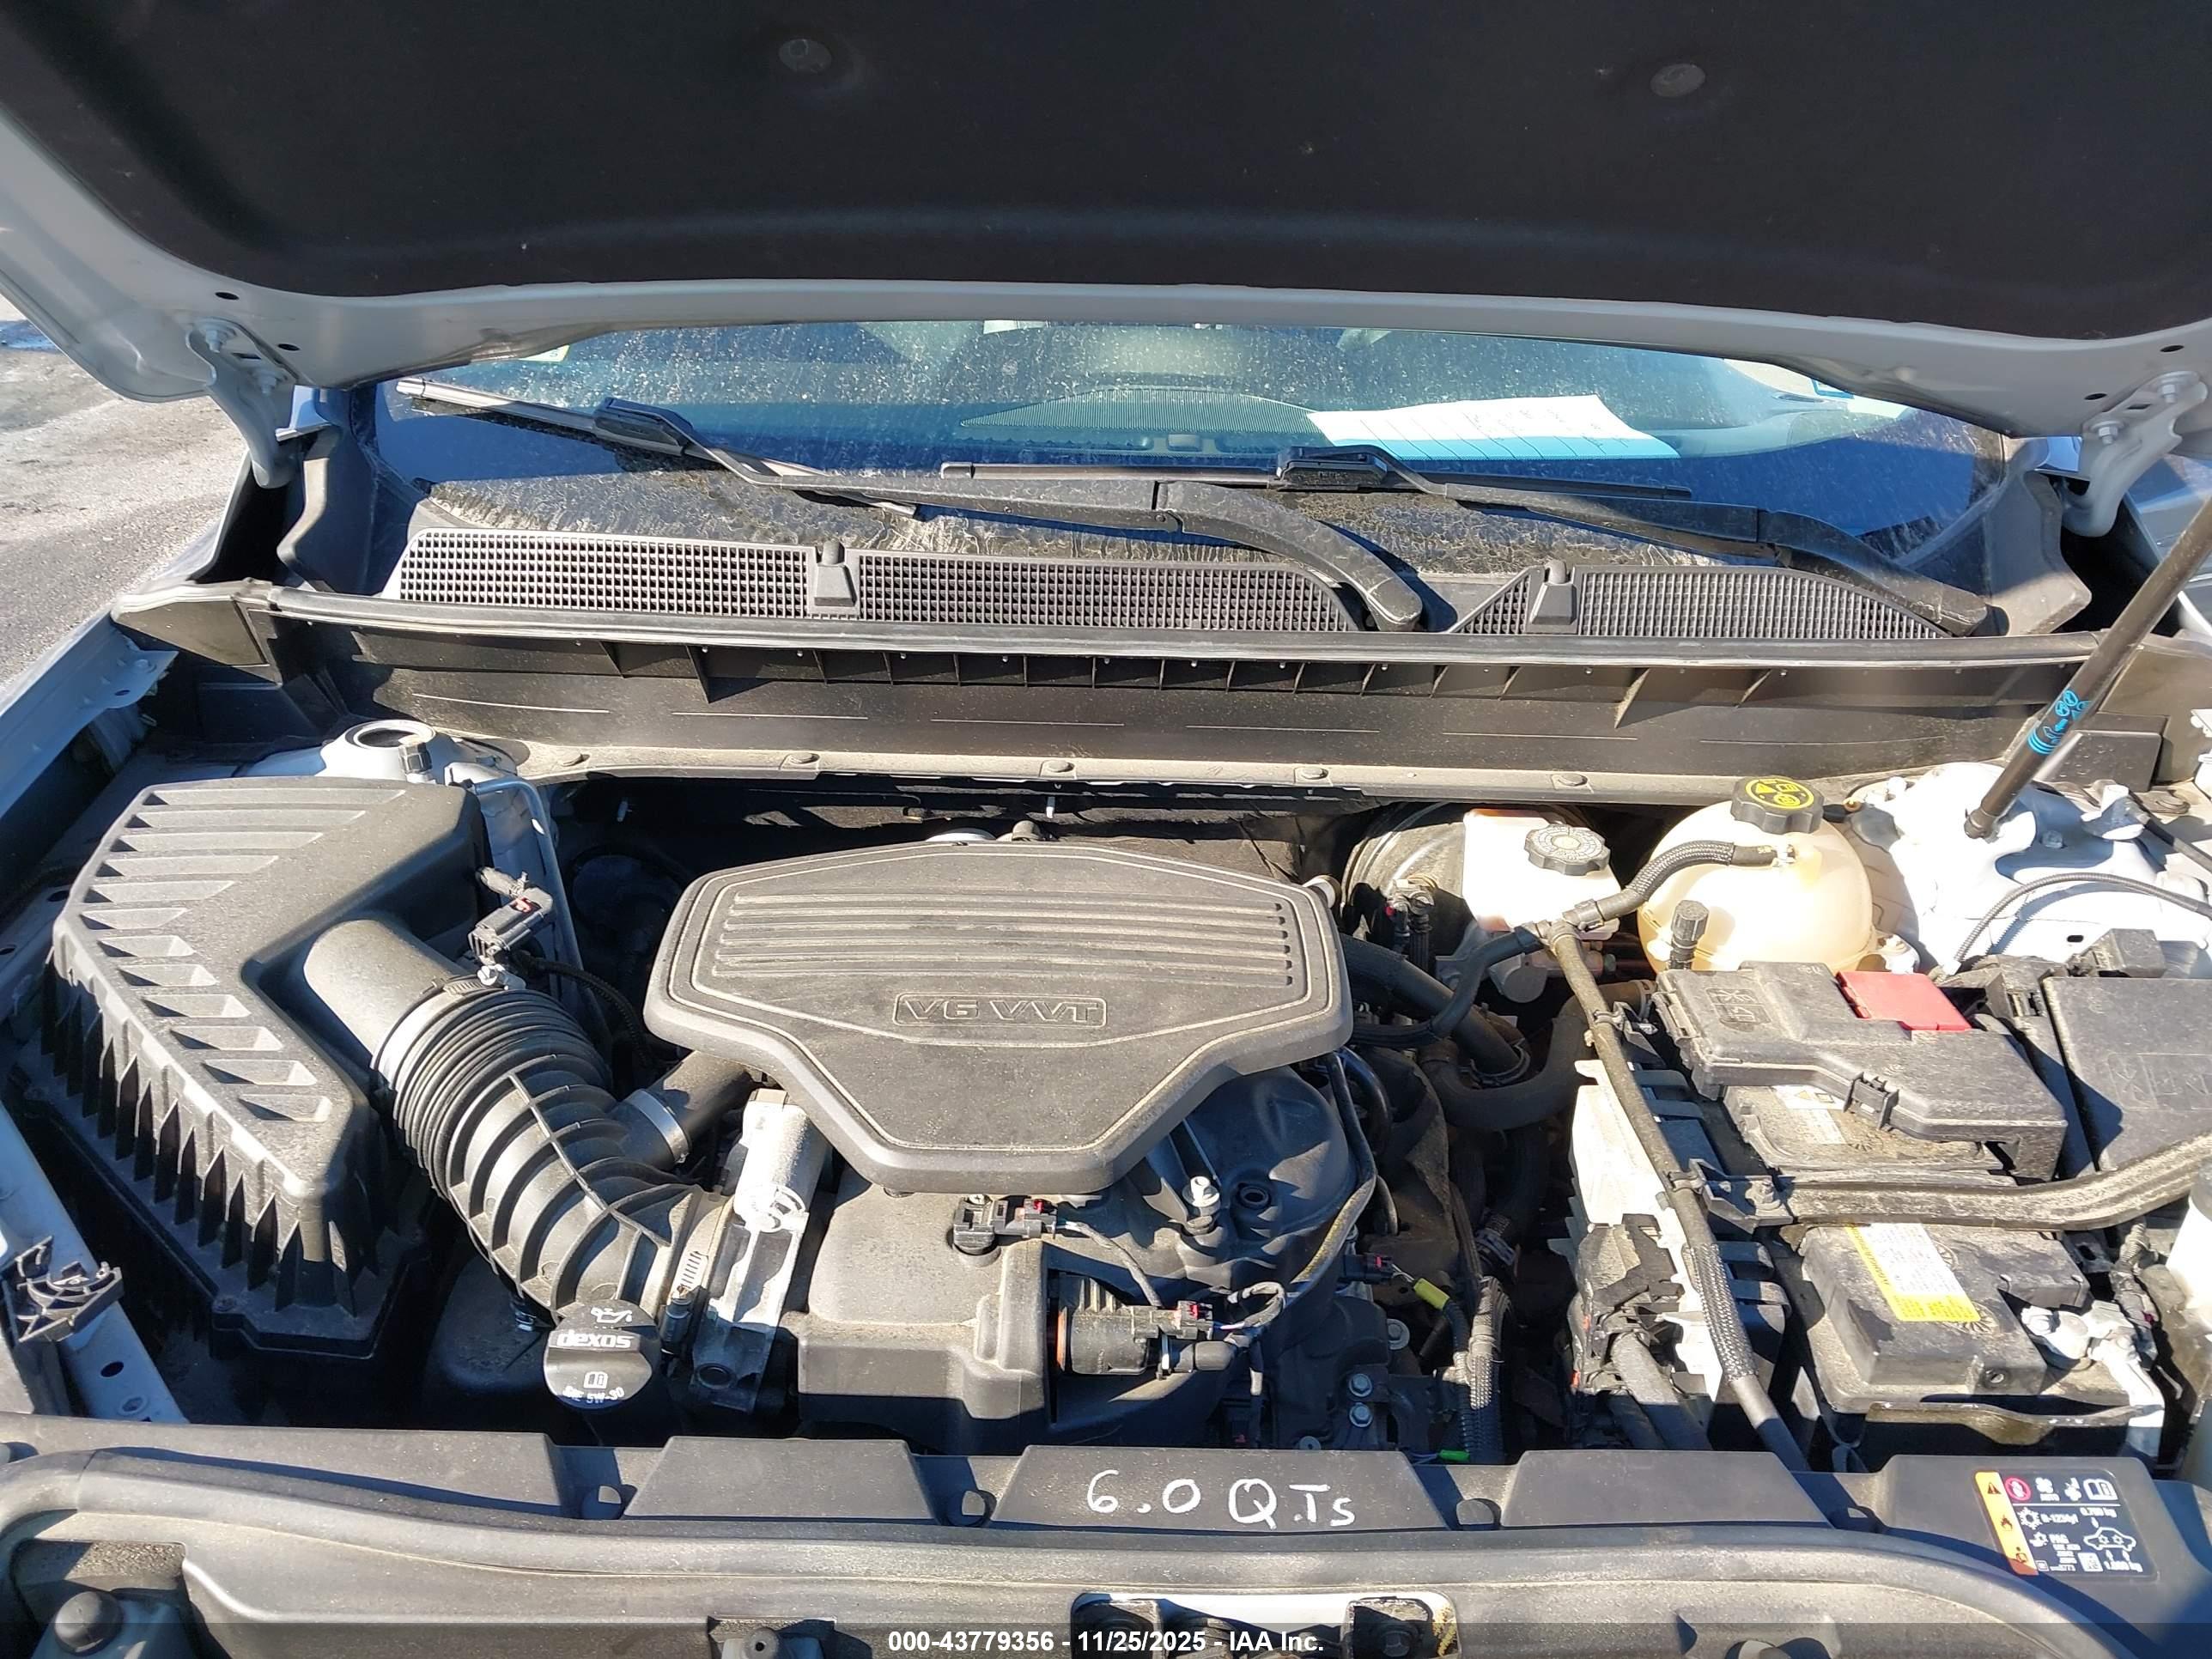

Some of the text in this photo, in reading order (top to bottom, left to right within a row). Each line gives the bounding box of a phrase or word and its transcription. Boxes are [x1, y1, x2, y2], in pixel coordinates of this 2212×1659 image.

[905, 1000, 1099, 1023] V6 VVT
[556, 1329, 635, 1349] dexos
[562, 1385, 625, 1404] SAE 5W-30
[1087, 1469, 1201, 1513] 6.0
